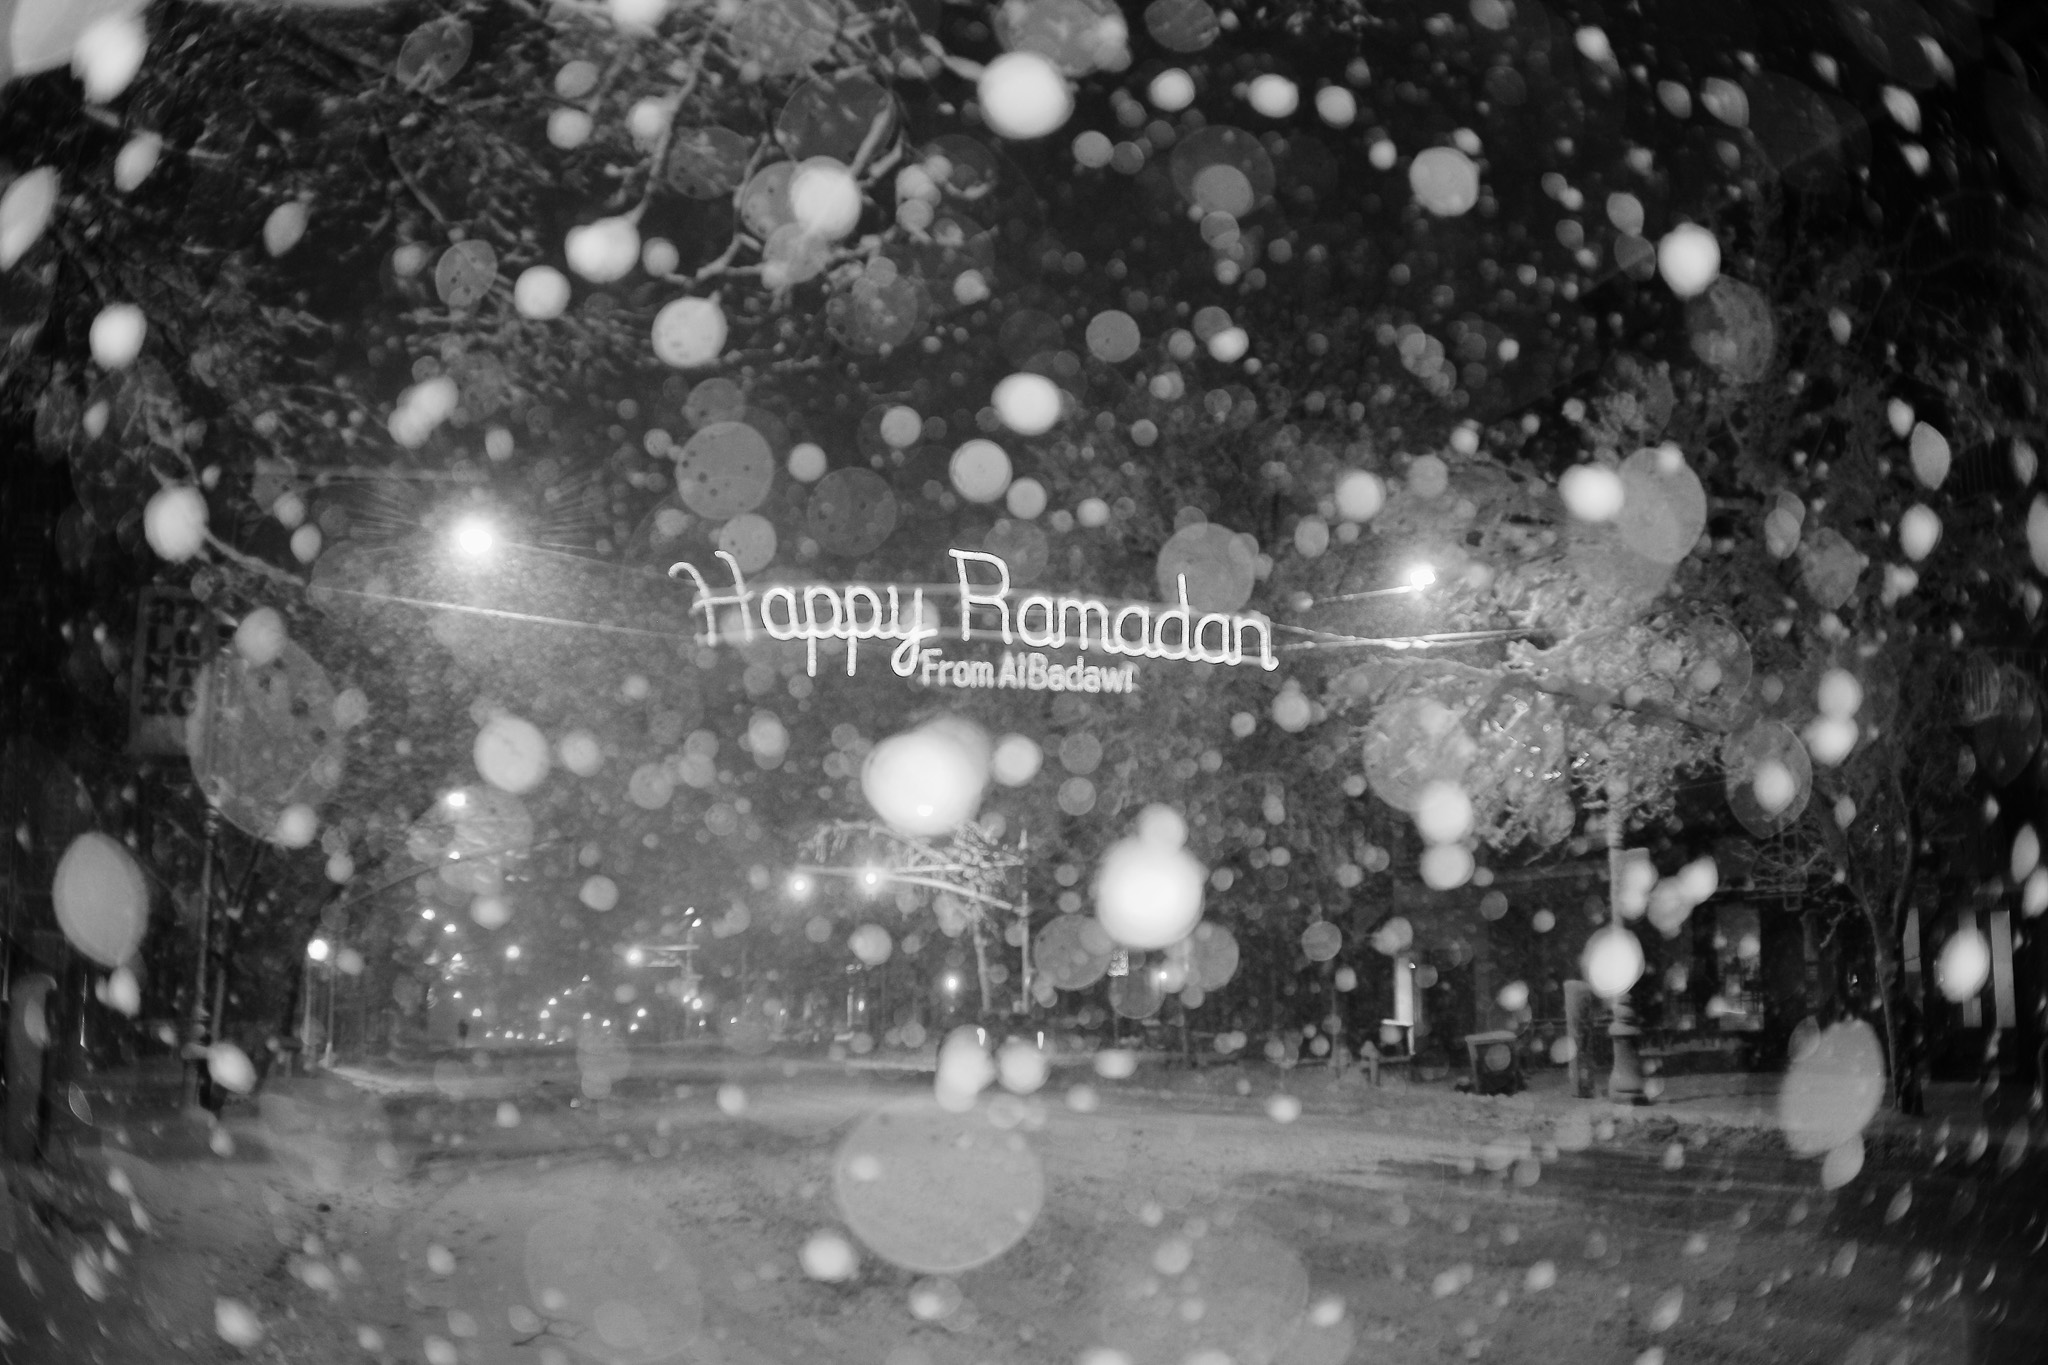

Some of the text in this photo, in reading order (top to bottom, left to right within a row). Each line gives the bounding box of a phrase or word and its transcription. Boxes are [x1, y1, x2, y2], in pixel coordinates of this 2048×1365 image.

[668, 548, 1279, 677] Happy Ramadan
[919, 648, 995, 688] From
